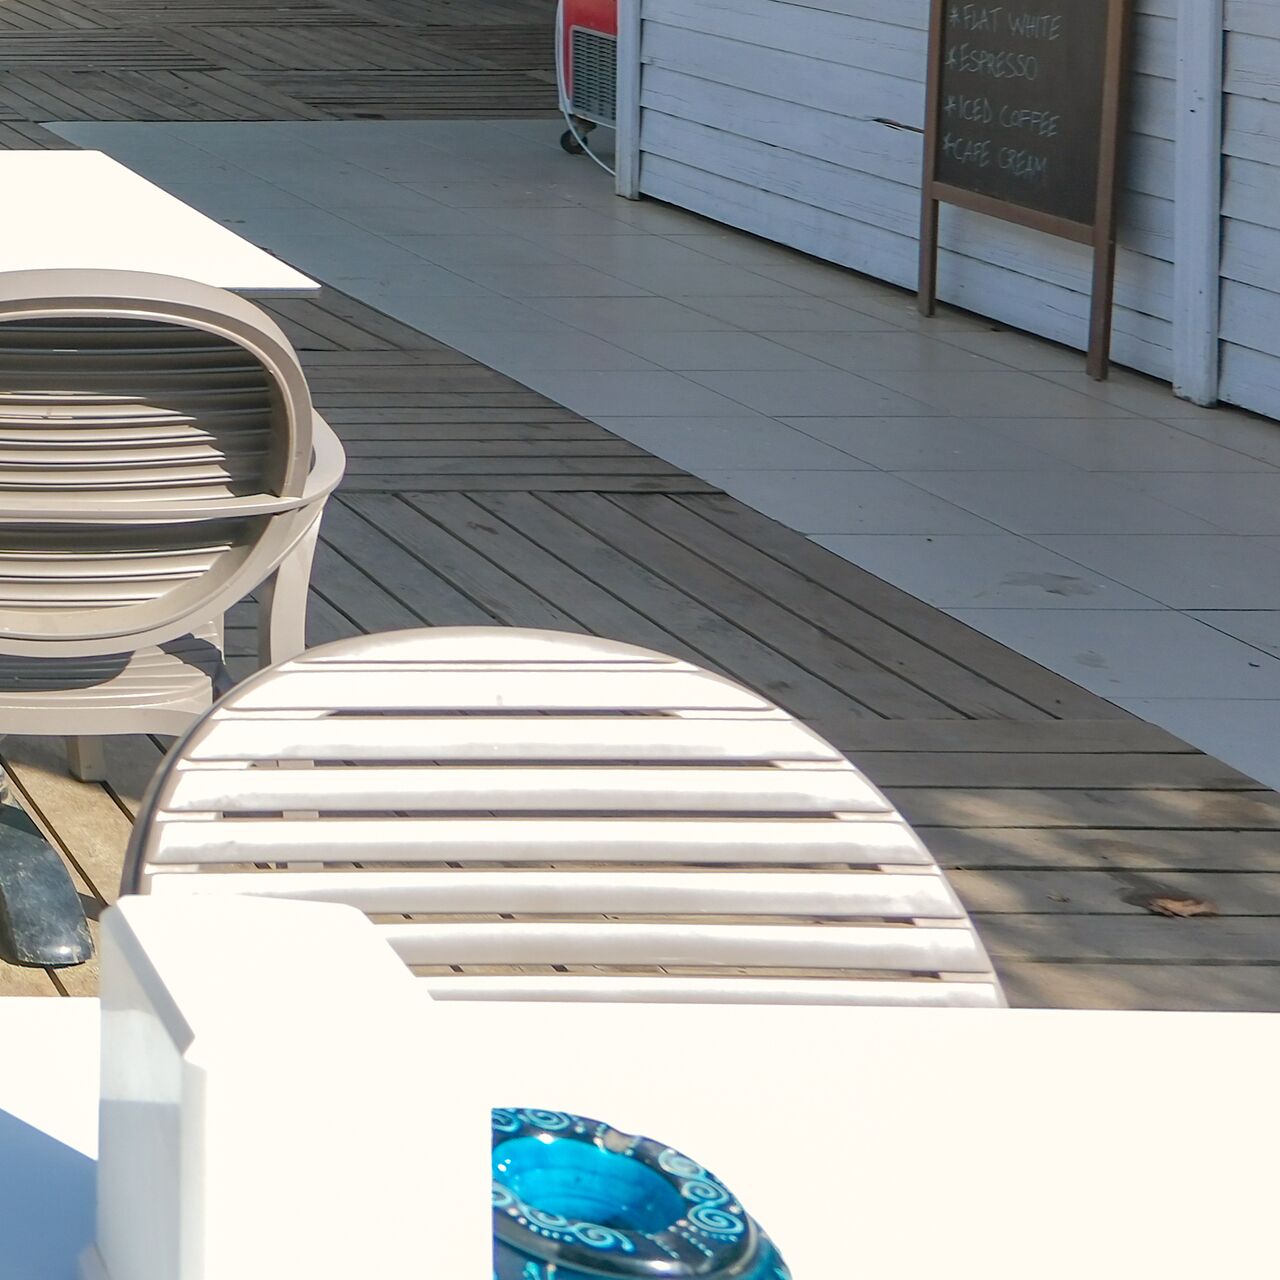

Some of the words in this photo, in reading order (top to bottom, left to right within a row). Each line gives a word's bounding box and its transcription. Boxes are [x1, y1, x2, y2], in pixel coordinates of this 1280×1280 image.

[963, 4, 1003, 32] FLAT
[1008, 12, 1063, 40] WHITE
[959, 42, 1039, 81] ESPRESSO
[959, 95, 993, 124] ICED
[1000, 105, 1061, 137] COFFEE
[953, 138, 991, 168] CAFE
[999, 147, 1048, 180] CREAM
